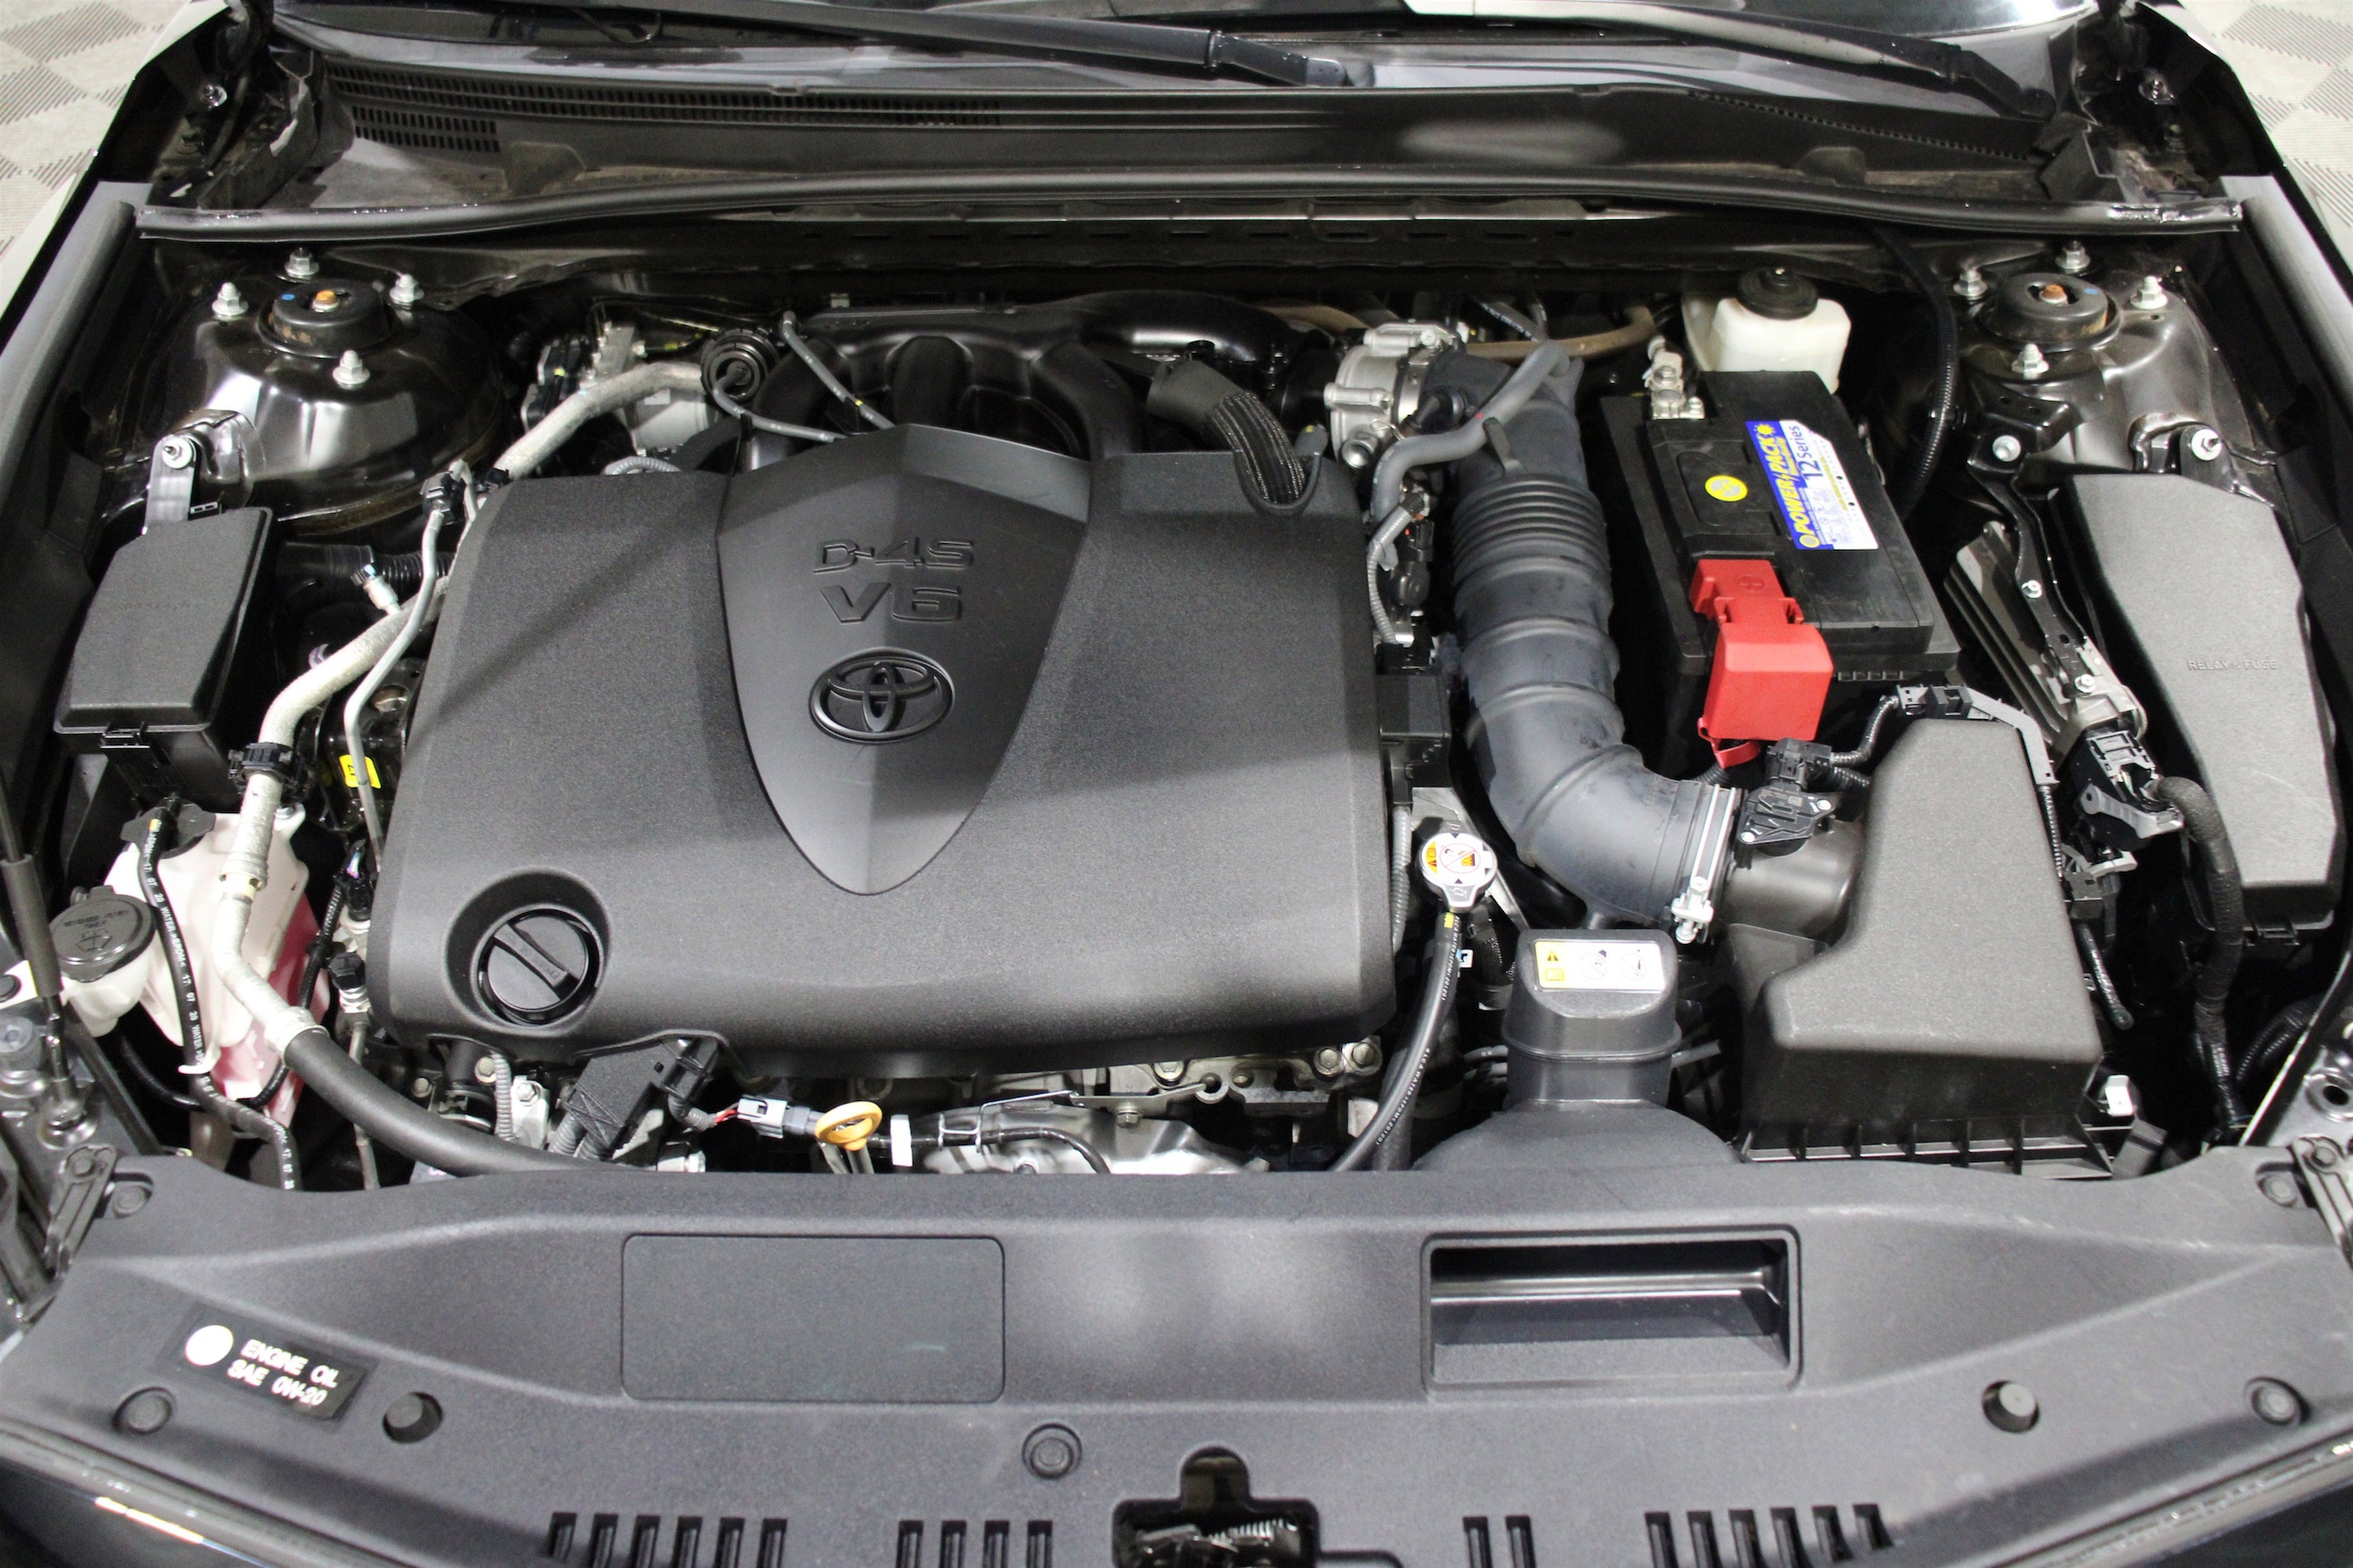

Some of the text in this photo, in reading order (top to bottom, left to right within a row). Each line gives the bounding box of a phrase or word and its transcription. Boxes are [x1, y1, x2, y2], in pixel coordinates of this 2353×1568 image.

[1756, 433, 1790, 475] PACK
[1789, 425, 1813, 459] Series
[1797, 460, 1823, 481] 12
[1775, 479, 1811, 535] POWER
[813, 537, 975, 575] D-4S
[820, 582, 963, 625] V6
[2186, 659, 2230, 671] RELAY
[2244, 659, 2280, 671] FUSE
[161, 906, 176, 932] WATER
[227, 1359, 328, 1406] SAE 0W-20
[240, 1338, 340, 1389] ENGINE OIL
